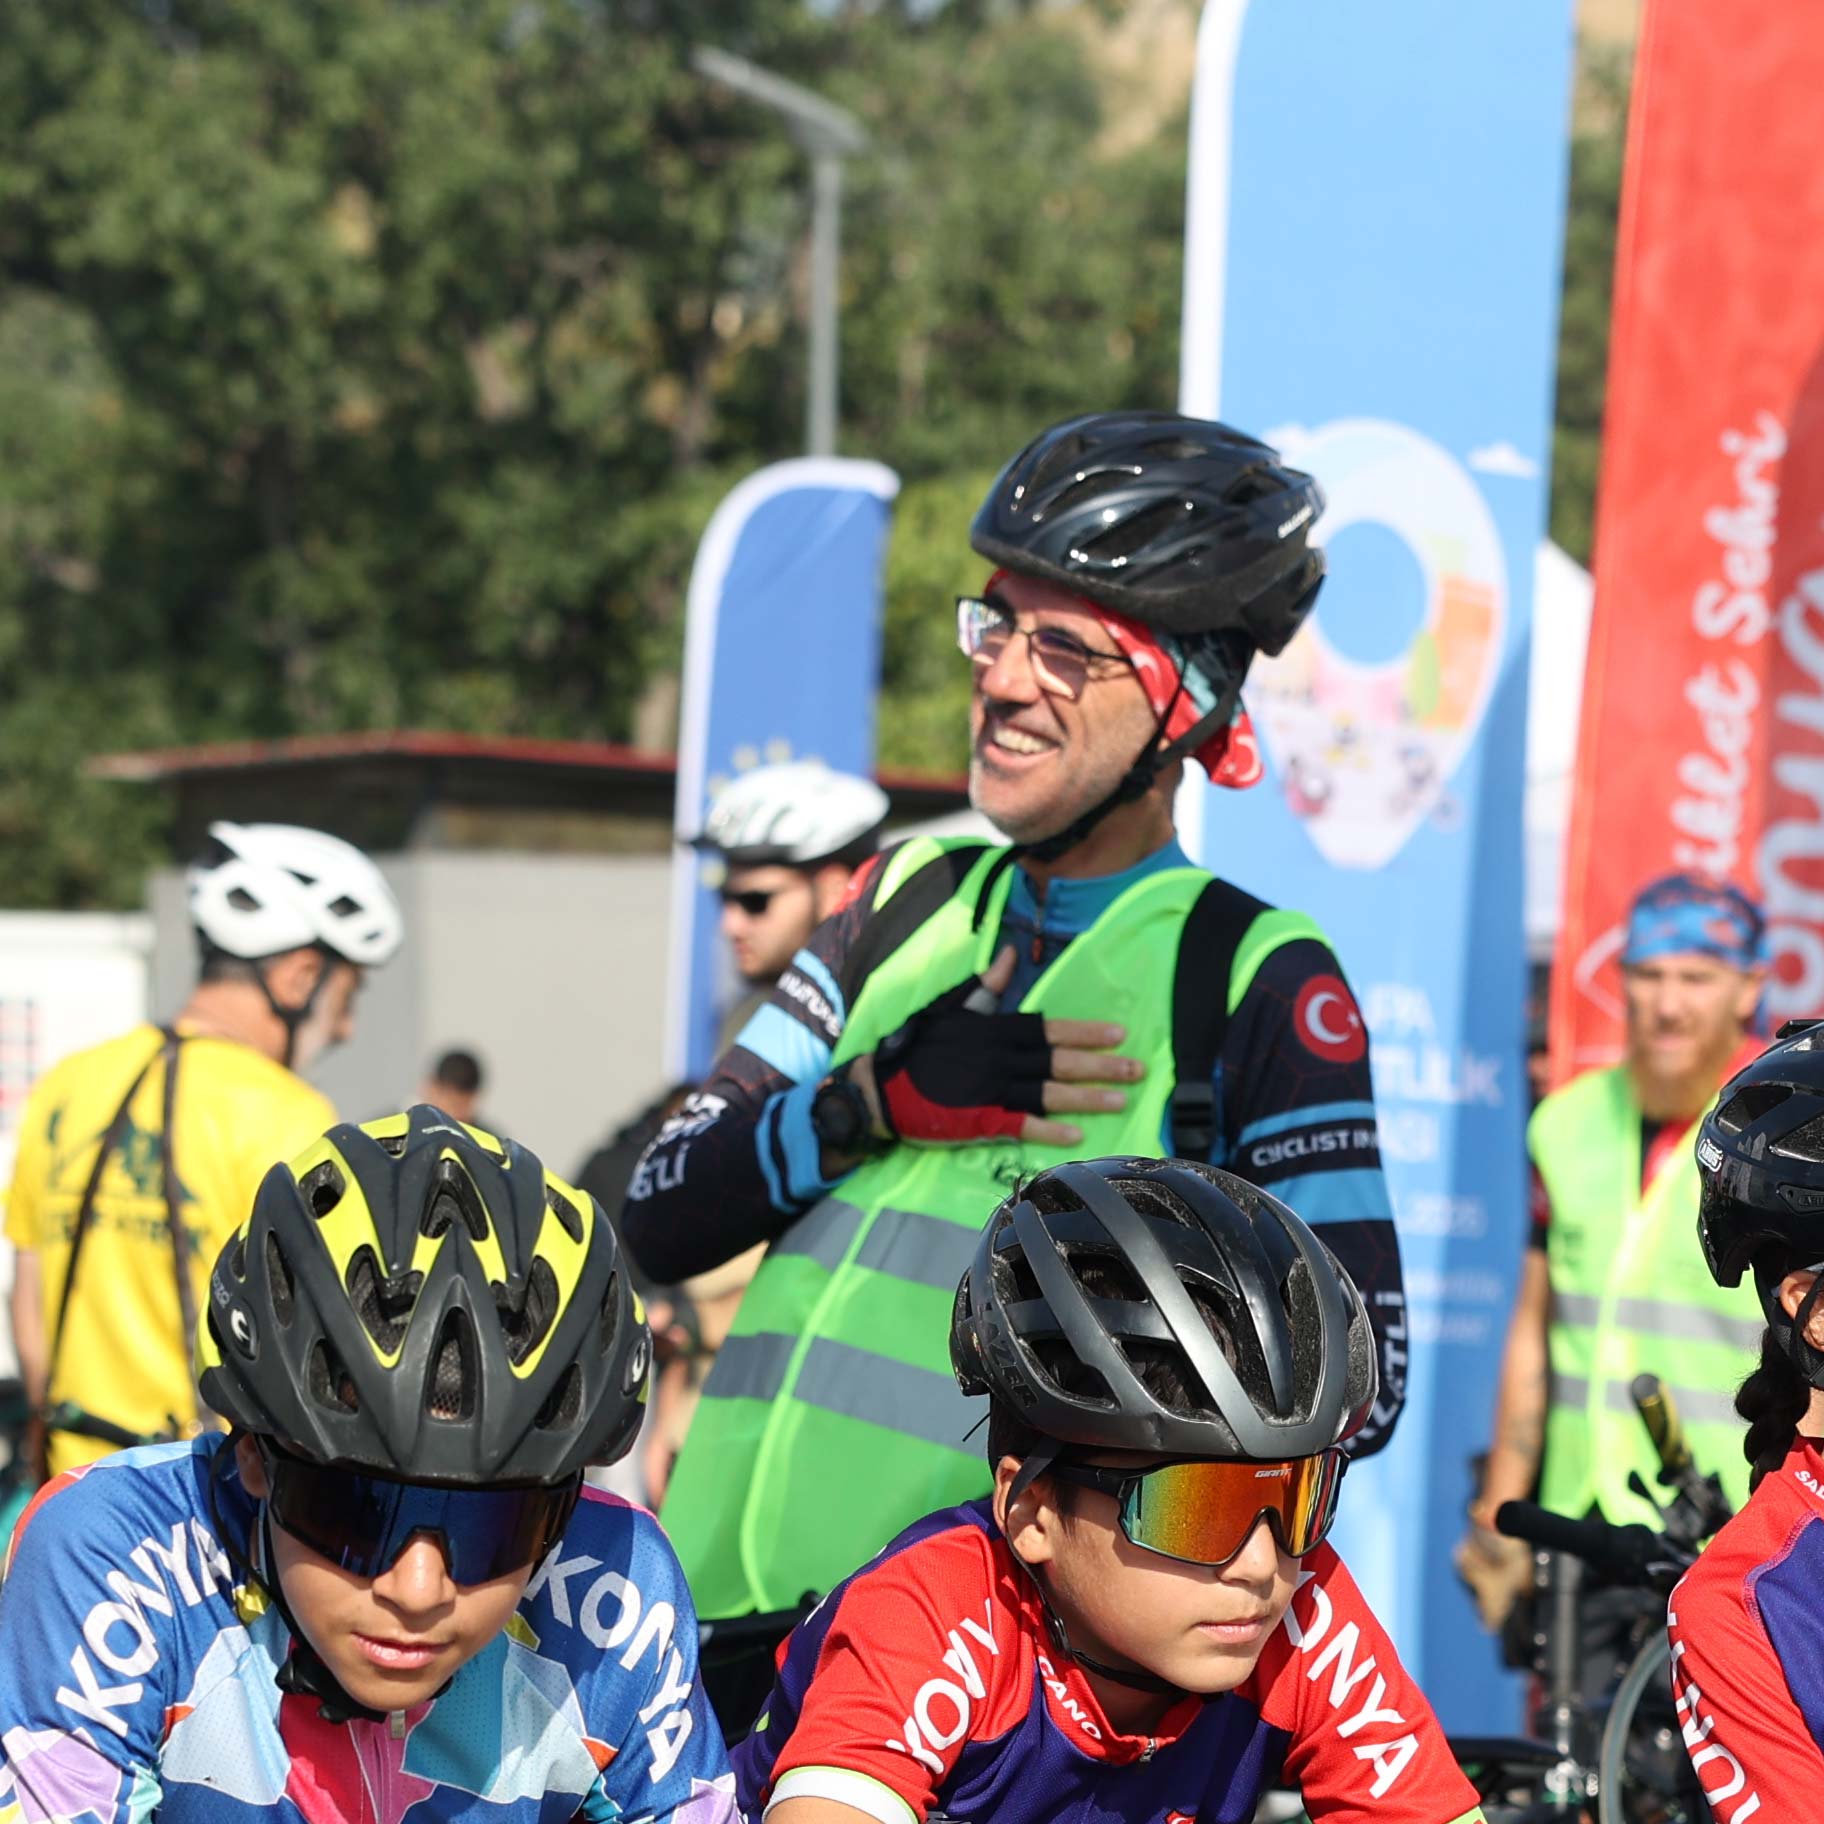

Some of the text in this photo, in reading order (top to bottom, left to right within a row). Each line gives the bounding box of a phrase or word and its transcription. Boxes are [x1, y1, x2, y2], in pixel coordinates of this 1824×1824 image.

[1672, 657, 1760, 878] iklet
[55, 1521, 234, 1738] KONYA
[524, 1537, 694, 1786] KONYA
[1035, 1653, 1102, 1743] CANO
